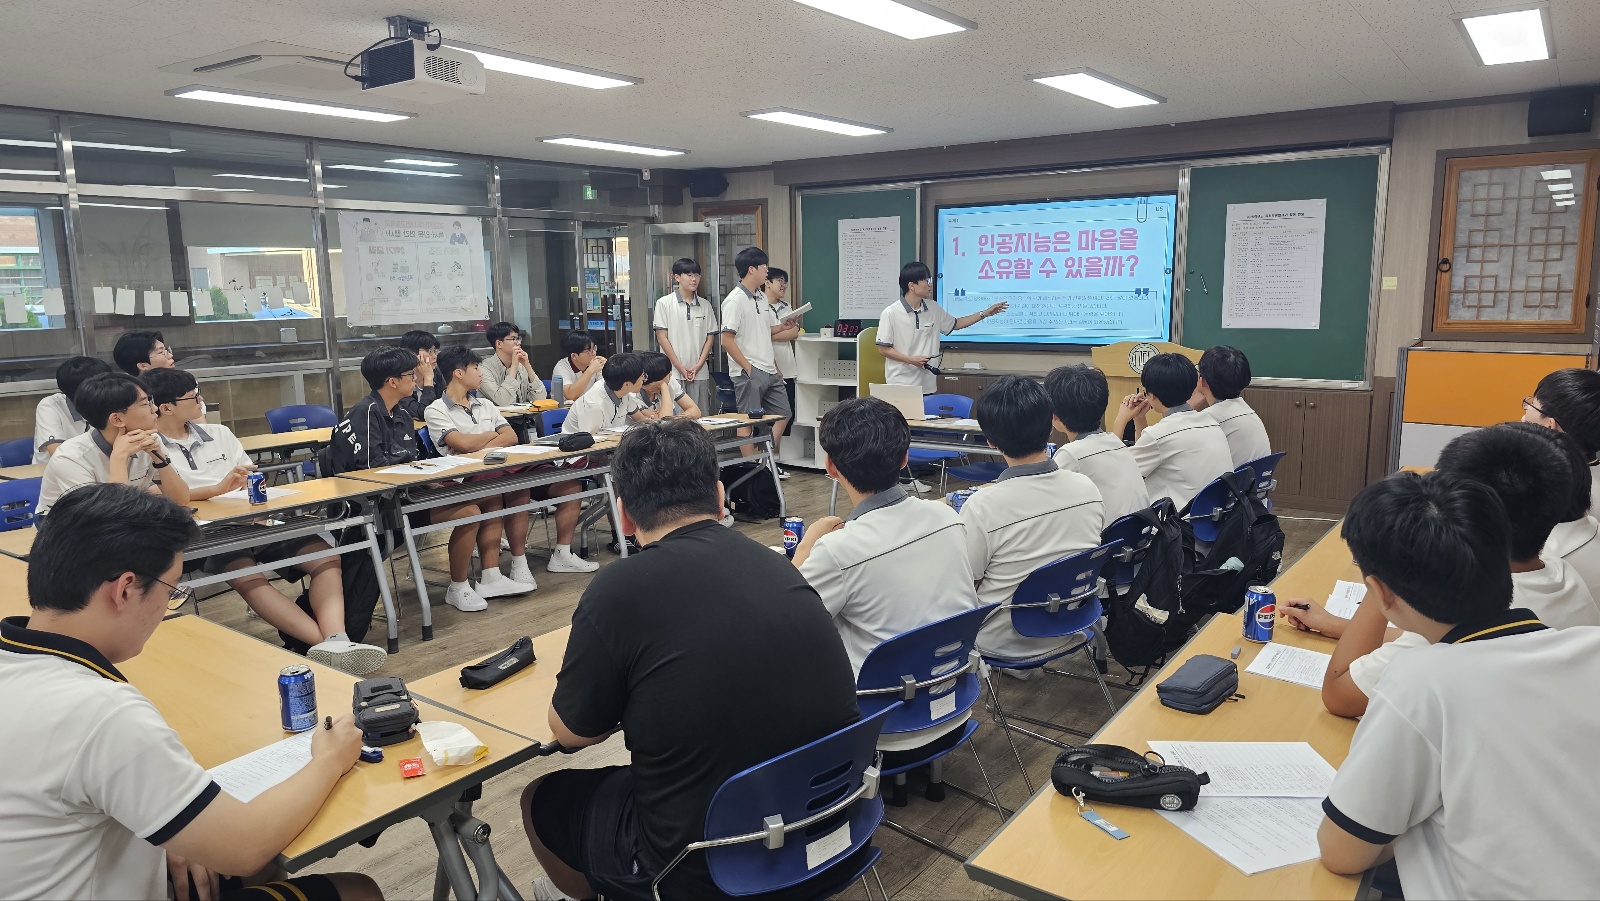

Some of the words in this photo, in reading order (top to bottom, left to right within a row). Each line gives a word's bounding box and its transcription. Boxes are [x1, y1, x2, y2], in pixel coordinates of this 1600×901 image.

[952, 236, 966, 256] 1.
[978, 231, 1071, 255] 인공지능은
[1077, 227, 1139, 251] 마음을
[977, 257, 1033, 280] 소유할
[1038, 257, 1058, 279] 수
[1064, 254, 1139, 279] 있을까?
